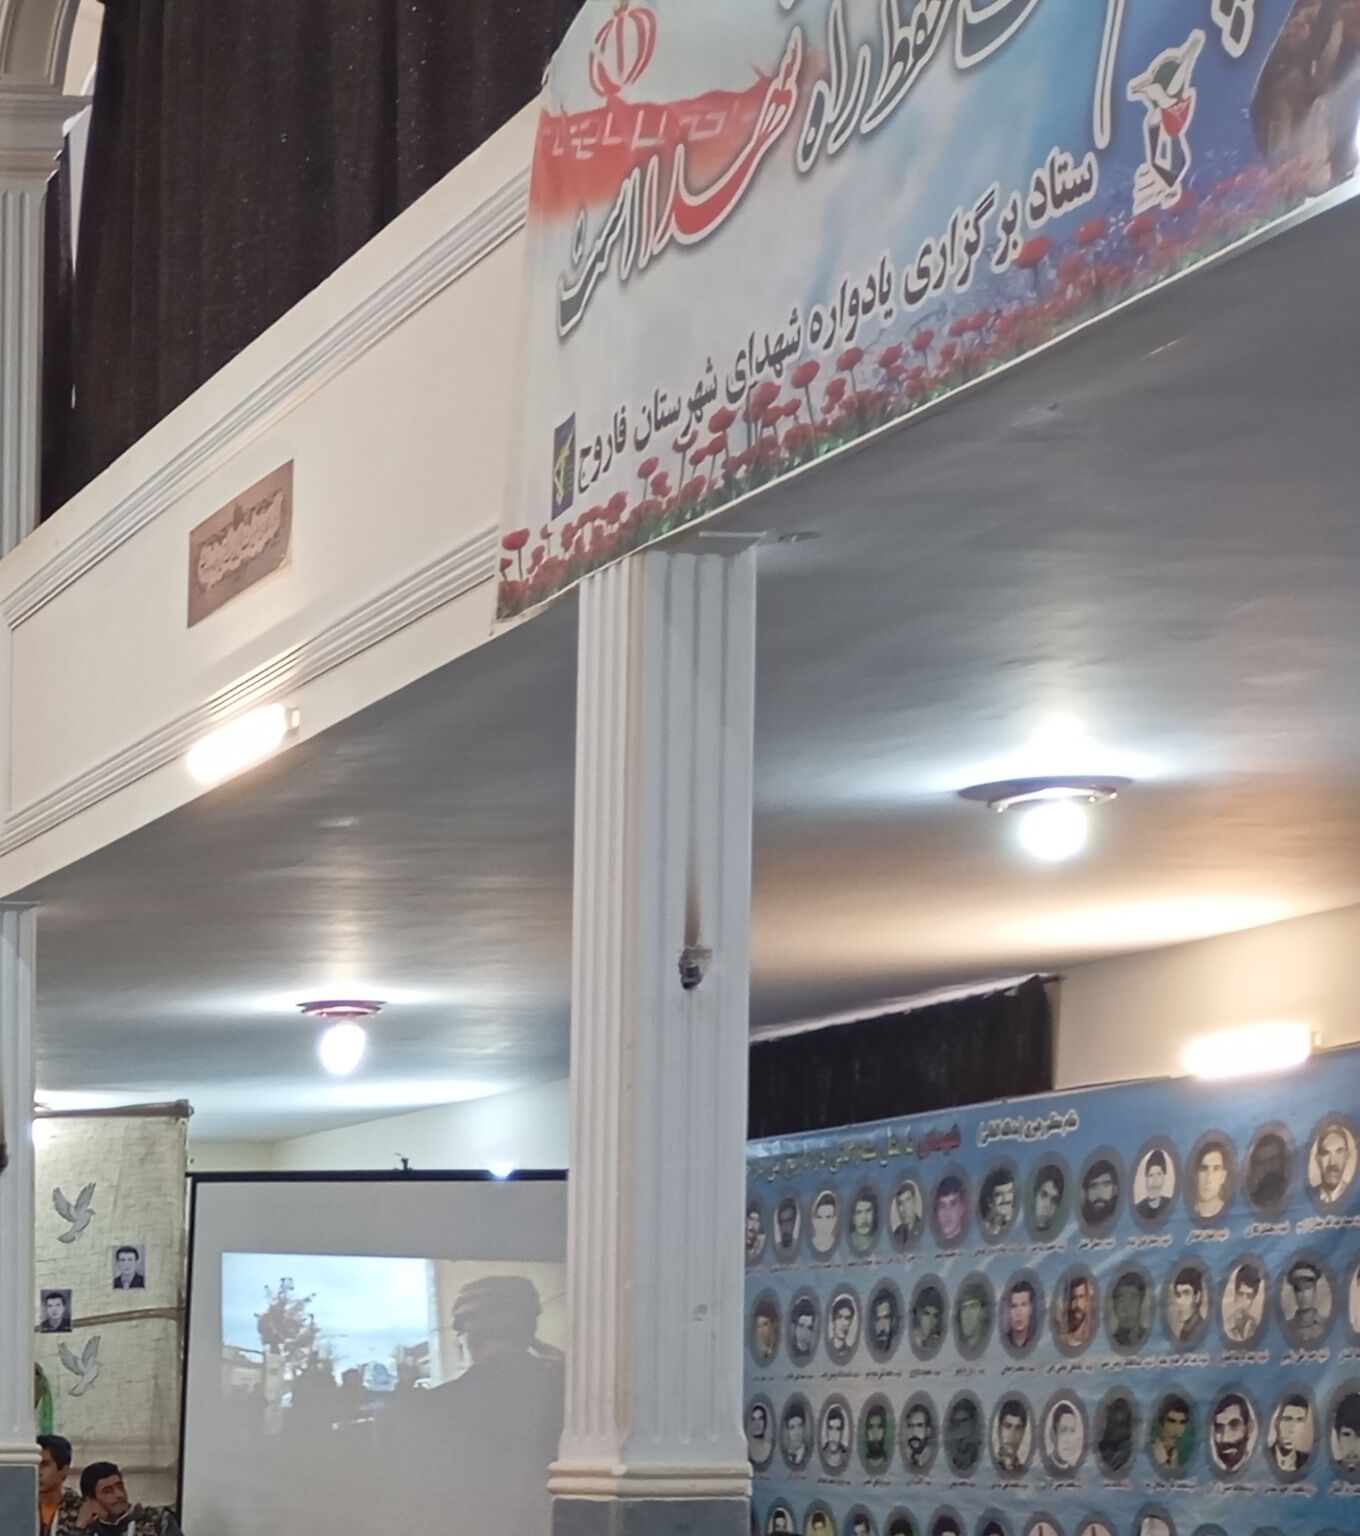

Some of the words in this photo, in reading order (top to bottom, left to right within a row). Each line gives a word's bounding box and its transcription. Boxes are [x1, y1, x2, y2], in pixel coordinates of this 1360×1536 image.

[1028, 145, 1098, 229] ستاد
[809, 257, 893, 350] یادواره
[725, 308, 801, 394] شهدای
[578, 405, 628, 492] فاروج
[634, 358, 718, 453] شهرستان
